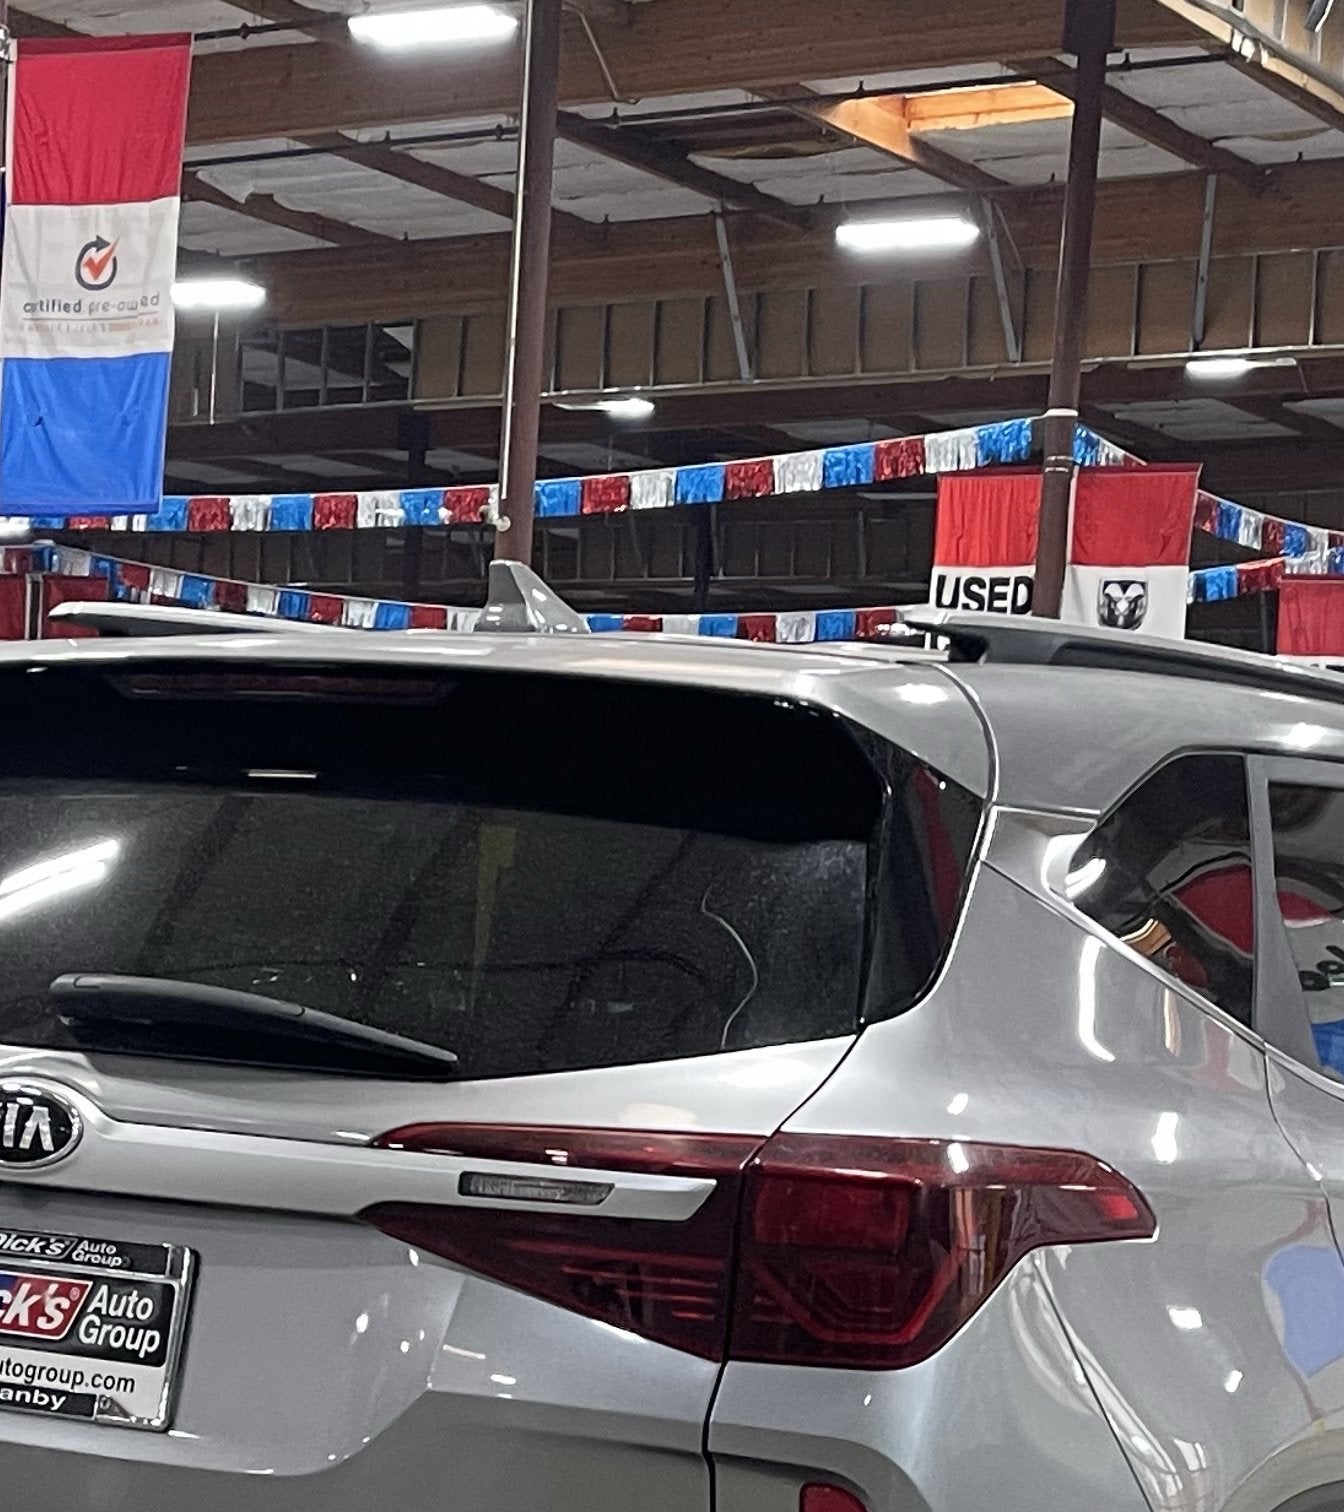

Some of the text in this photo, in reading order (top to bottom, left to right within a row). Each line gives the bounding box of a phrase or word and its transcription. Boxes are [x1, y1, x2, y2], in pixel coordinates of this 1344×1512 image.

[935, 574, 1034, 615] USED
[71, 1250, 122, 1268] Group
[76, 1239, 117, 1255] Auto
[86, 1284, 155, 1322] Auto
[78, 1314, 161, 1359] Group
